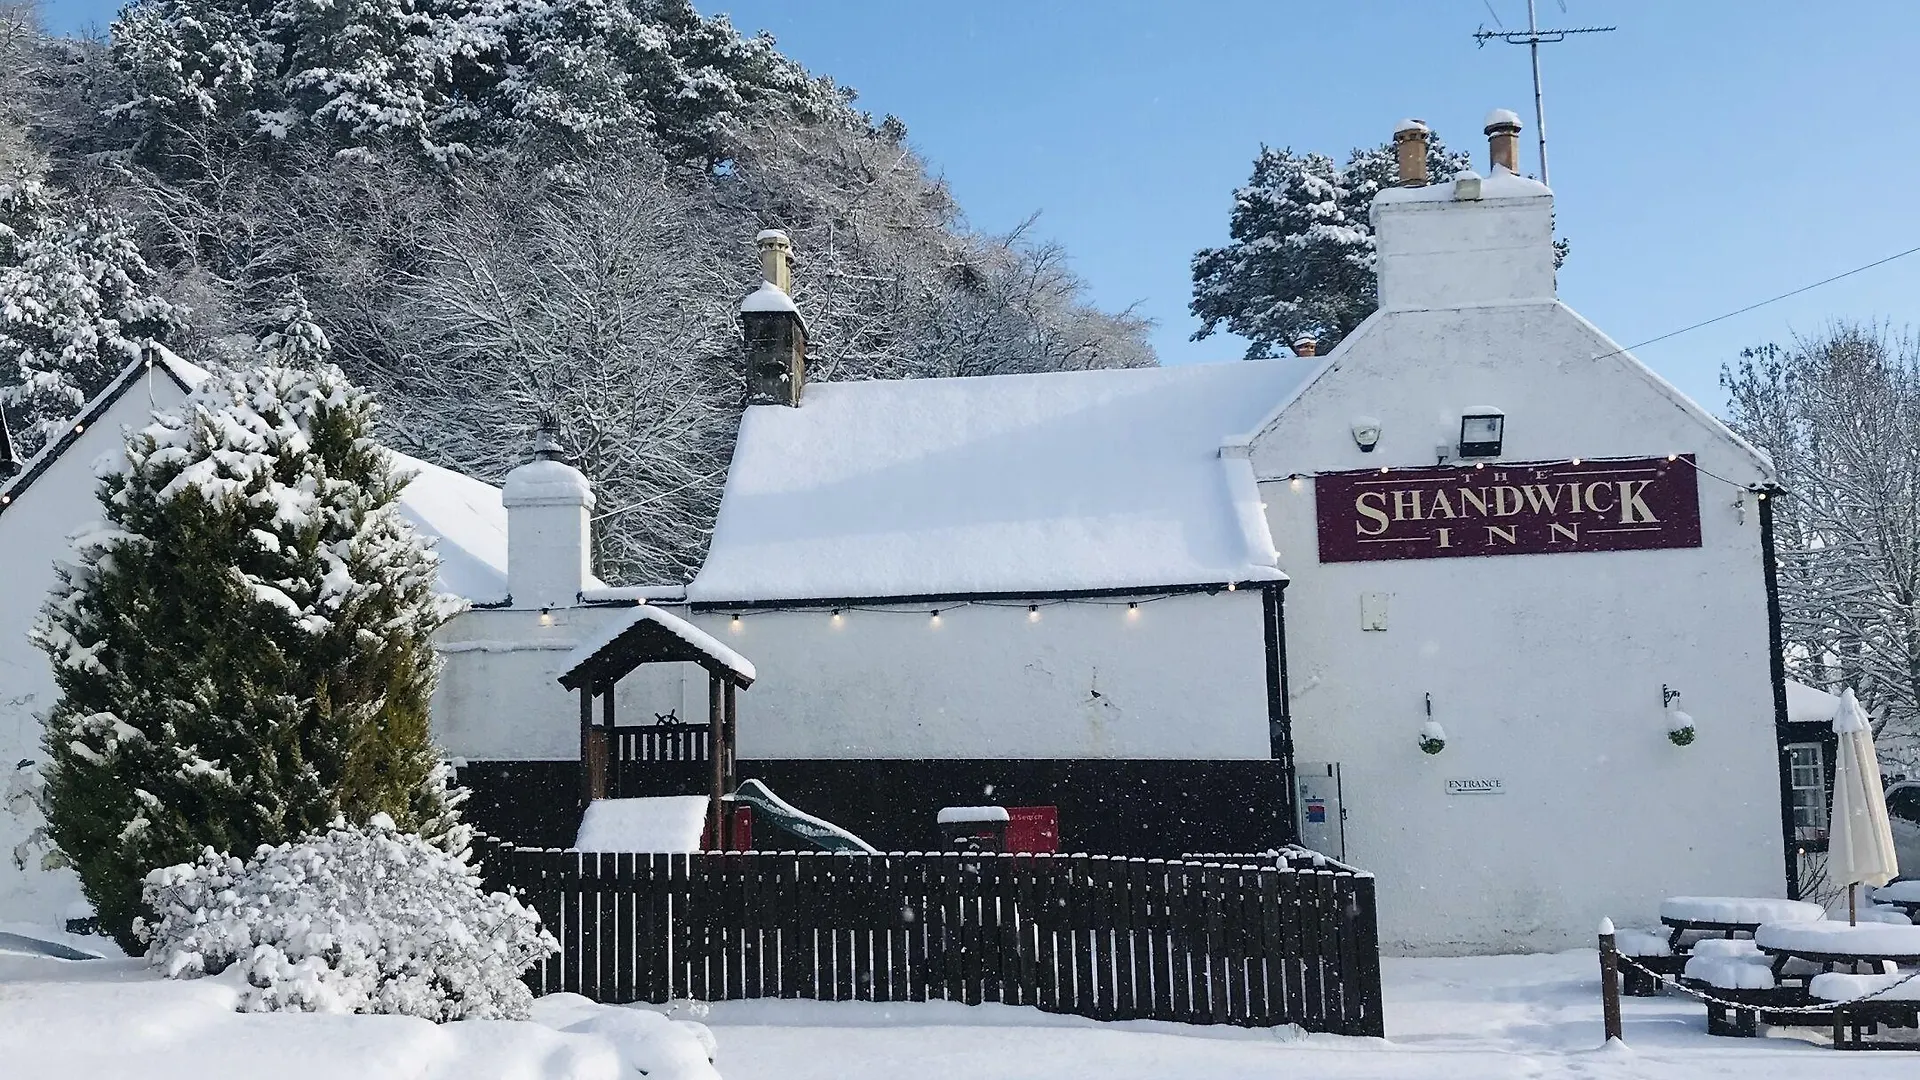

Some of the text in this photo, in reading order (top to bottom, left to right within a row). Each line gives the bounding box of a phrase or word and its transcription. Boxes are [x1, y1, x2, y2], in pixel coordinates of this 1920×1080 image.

[1461, 471, 1550, 483] THE
[1355, 480, 1660, 536] SHANDWICK
[1436, 522, 1582, 548] INN
[1448, 779, 1502, 788] ENTRANCE
